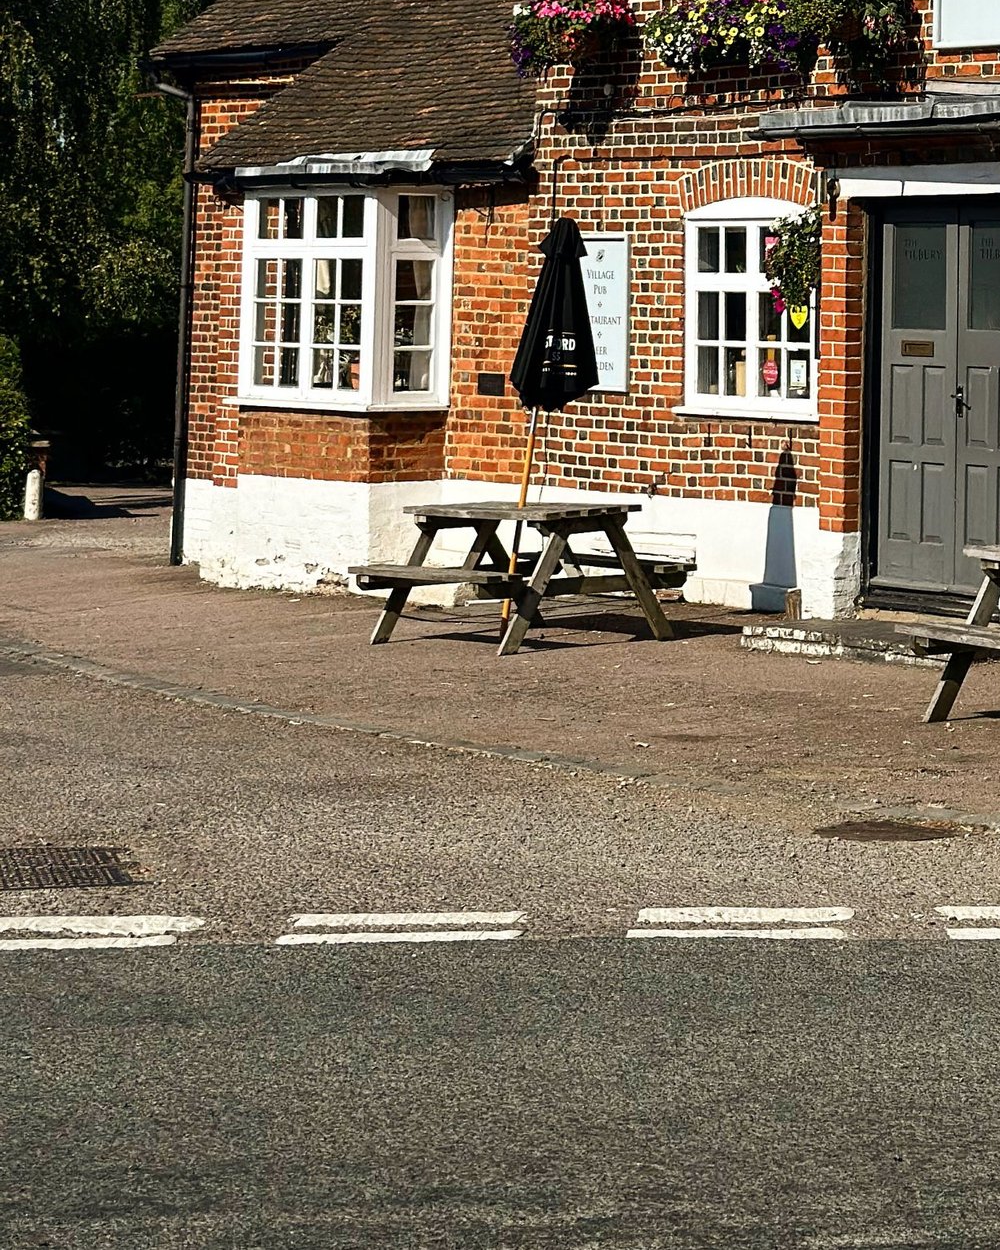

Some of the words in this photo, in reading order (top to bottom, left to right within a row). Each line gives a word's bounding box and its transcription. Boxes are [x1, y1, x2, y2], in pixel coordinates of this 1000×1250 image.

[587, 270, 615, 280] VILLAGE
[593, 284, 607, 294] PUB
[590, 315, 622, 325] TAURANT
[595, 346, 608, 355] EER
[597, 362, 614, 370] DEN
